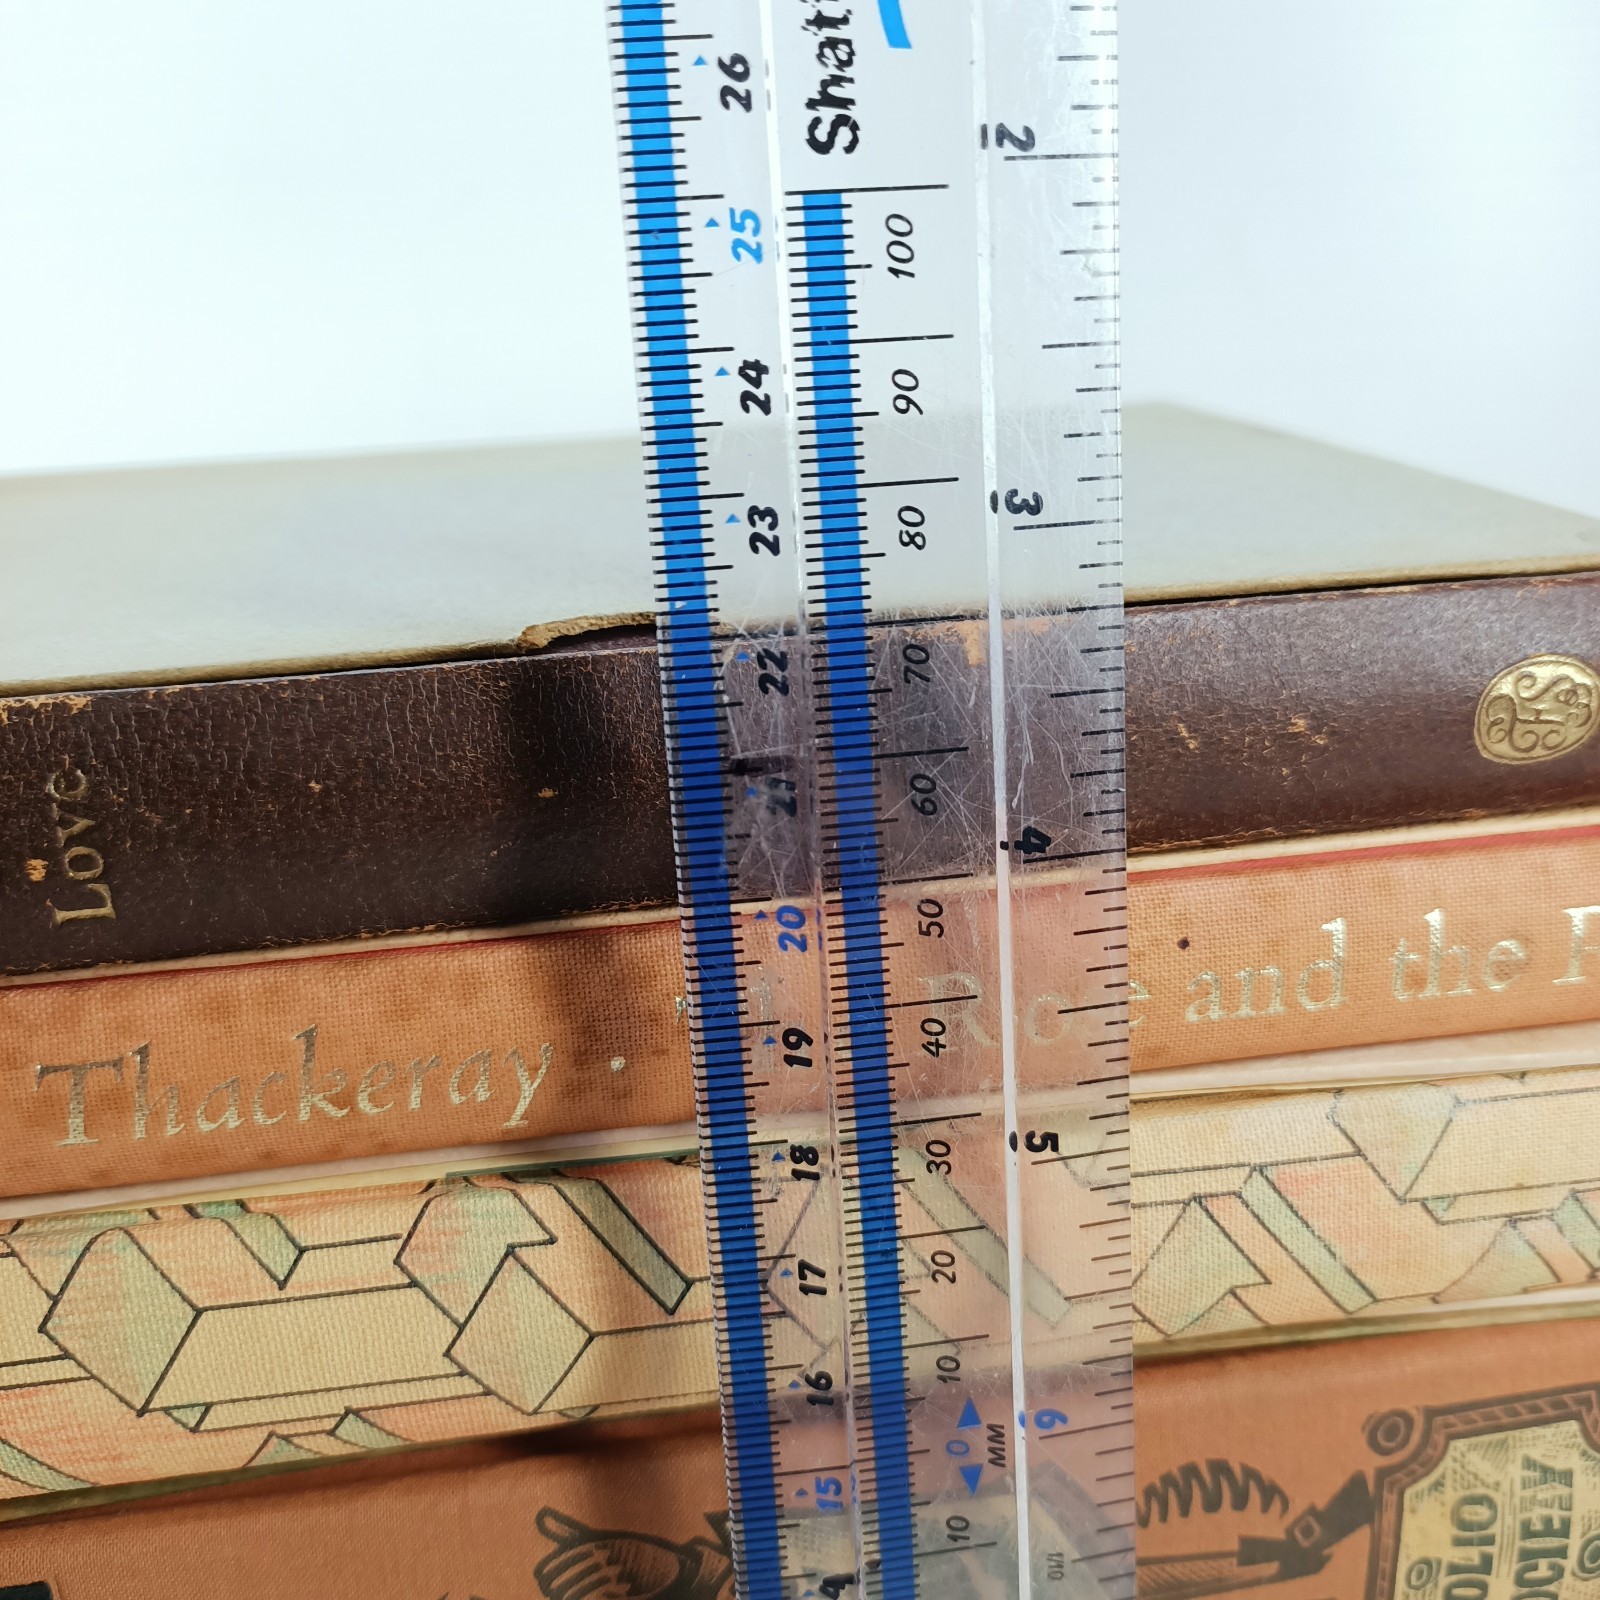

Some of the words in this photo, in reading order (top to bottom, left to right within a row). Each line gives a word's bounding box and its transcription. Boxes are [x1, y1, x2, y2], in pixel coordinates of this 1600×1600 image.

[718, 52, 753, 113] 26
[802, 0, 861, 156] Shat
[995, 123, 1036, 153] 2
[729, 207, 764, 264] 25
[885, 213, 917, 279] 100
[738, 359, 772, 416] 24
[892, 368, 924, 416] 90
[1005, 488, 1044, 518] 3
[747, 505, 781, 557] 23
[898, 505, 928, 550] 80
[758, 645, 791, 697] 22
[903, 643, 932, 685] 70
[910, 773, 939, 817] 60
[46, 767, 117, 929] Love
[1014, 827, 1052, 854] 4
[777, 905, 809, 953] 20
[918, 898, 946, 939] 50
[1184, 917, 1349, 1025] and
[1391, 907, 1527, 1002] the
[782, 1027, 815, 1068] 19
[920, 1017, 948, 1058] 40
[33, 1023, 556, 1149] Thackeray
[925, 1139, 953, 1176] 30
[1025, 1130, 1061, 1154] 5
[789, 1145, 820, 1182] 18
[798, 1259, 828, 1297] 17
[930, 1249, 958, 1284] 20
[806, 1370, 835, 1406] 16
[936, 1354, 962, 1384] 10
[1034, 1408, 1069, 1431] 6
[946, 1439, 971, 1457] 0
[987, 1423, 1007, 1468] MM
[815, 1476, 844, 1513] 15
[946, 1515, 971, 1543] 10
